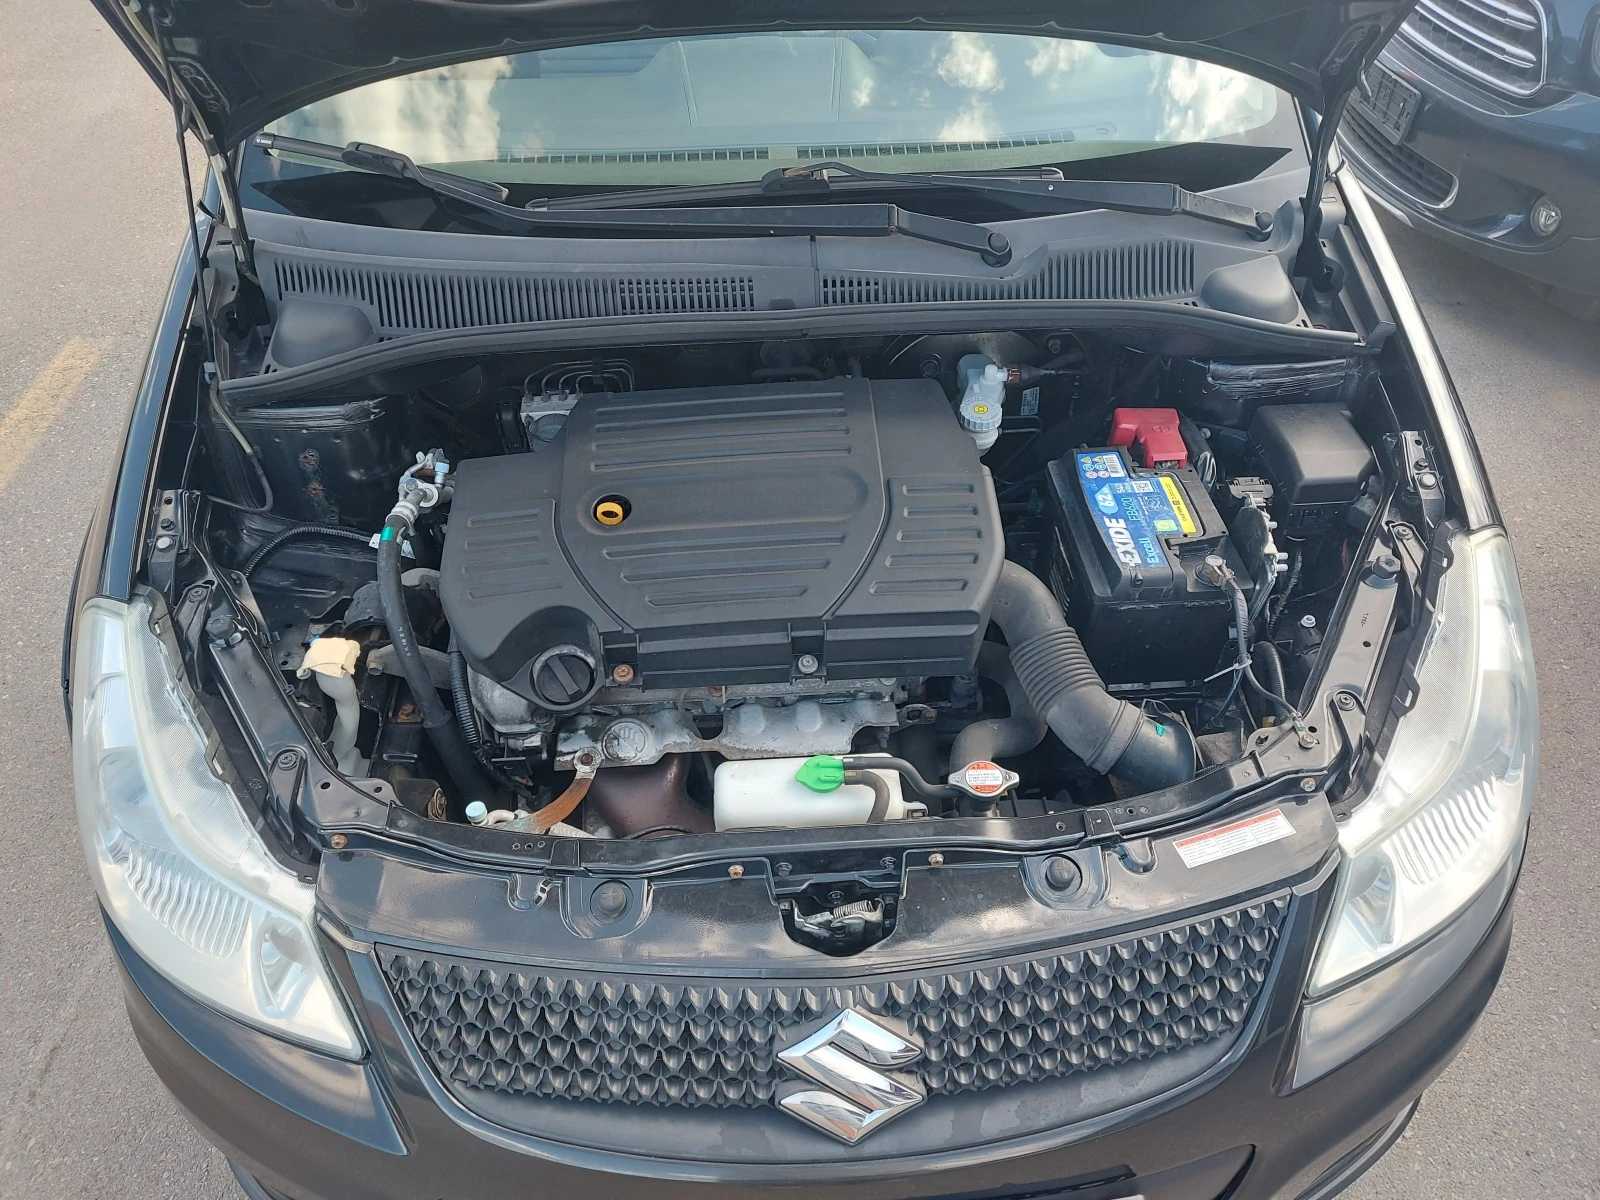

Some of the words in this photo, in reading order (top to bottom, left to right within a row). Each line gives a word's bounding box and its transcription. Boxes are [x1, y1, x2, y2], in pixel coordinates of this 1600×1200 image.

[1097, 494, 1115, 507] 62
[1121, 497, 1141, 521] EB620
[1104, 516, 1143, 567] EXIDE
[1139, 537, 1159, 564] Excell
